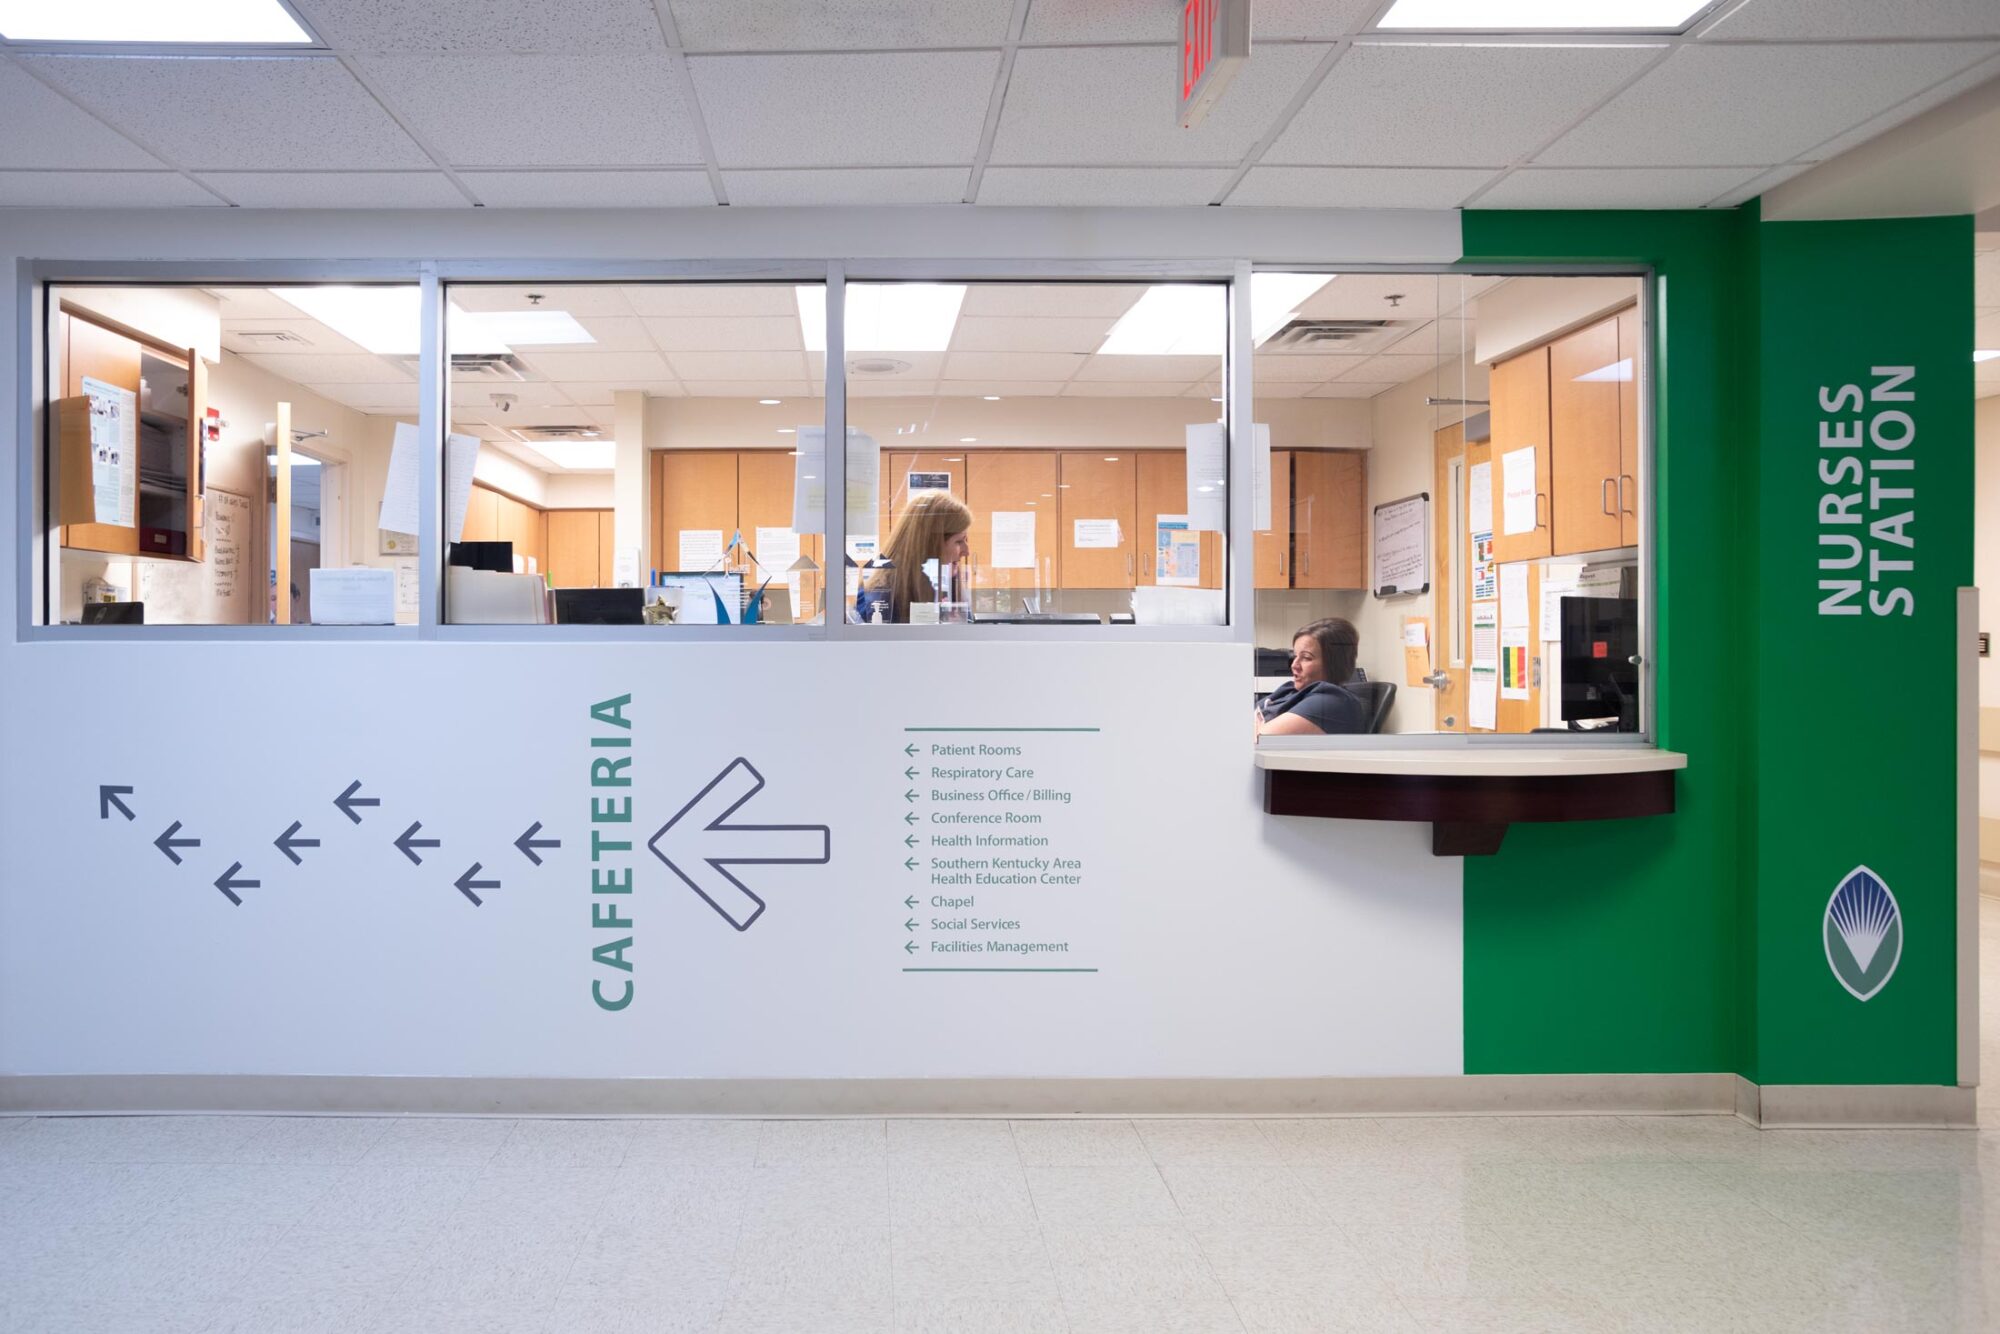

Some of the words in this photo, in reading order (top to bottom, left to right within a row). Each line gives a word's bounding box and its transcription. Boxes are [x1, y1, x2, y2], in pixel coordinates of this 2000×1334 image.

[1868, 365, 1916, 617] STATION
[1818, 383, 1865, 615] NURSES
[932, 744, 975, 756] Patient
[979, 744, 1021, 756] Rooms
[931, 767, 1003, 781] Respiratory
[1006, 767, 1034, 778] Care
[932, 789, 985, 801] Business
[931, 812, 1002, 823] Conference
[1005, 812, 1041, 823] Room
[932, 834, 972, 846] Health
[976, 834, 1048, 846] Information
[590, 692, 634, 1012] CAFETERIA
[931, 857, 989, 869] Southern
[991, 857, 1050, 872] Kentucky
[1053, 857, 1081, 869] Area
[931, 873, 972, 885] Health
[976, 873, 1037, 886] Education
[1040, 873, 1081, 884] Center
[931, 896, 974, 910] Chapel
[931, 918, 967, 930] Social
[971, 918, 1020, 930] Services
[931, 941, 983, 952] Facilities
[987, 941, 1069, 955] Management
